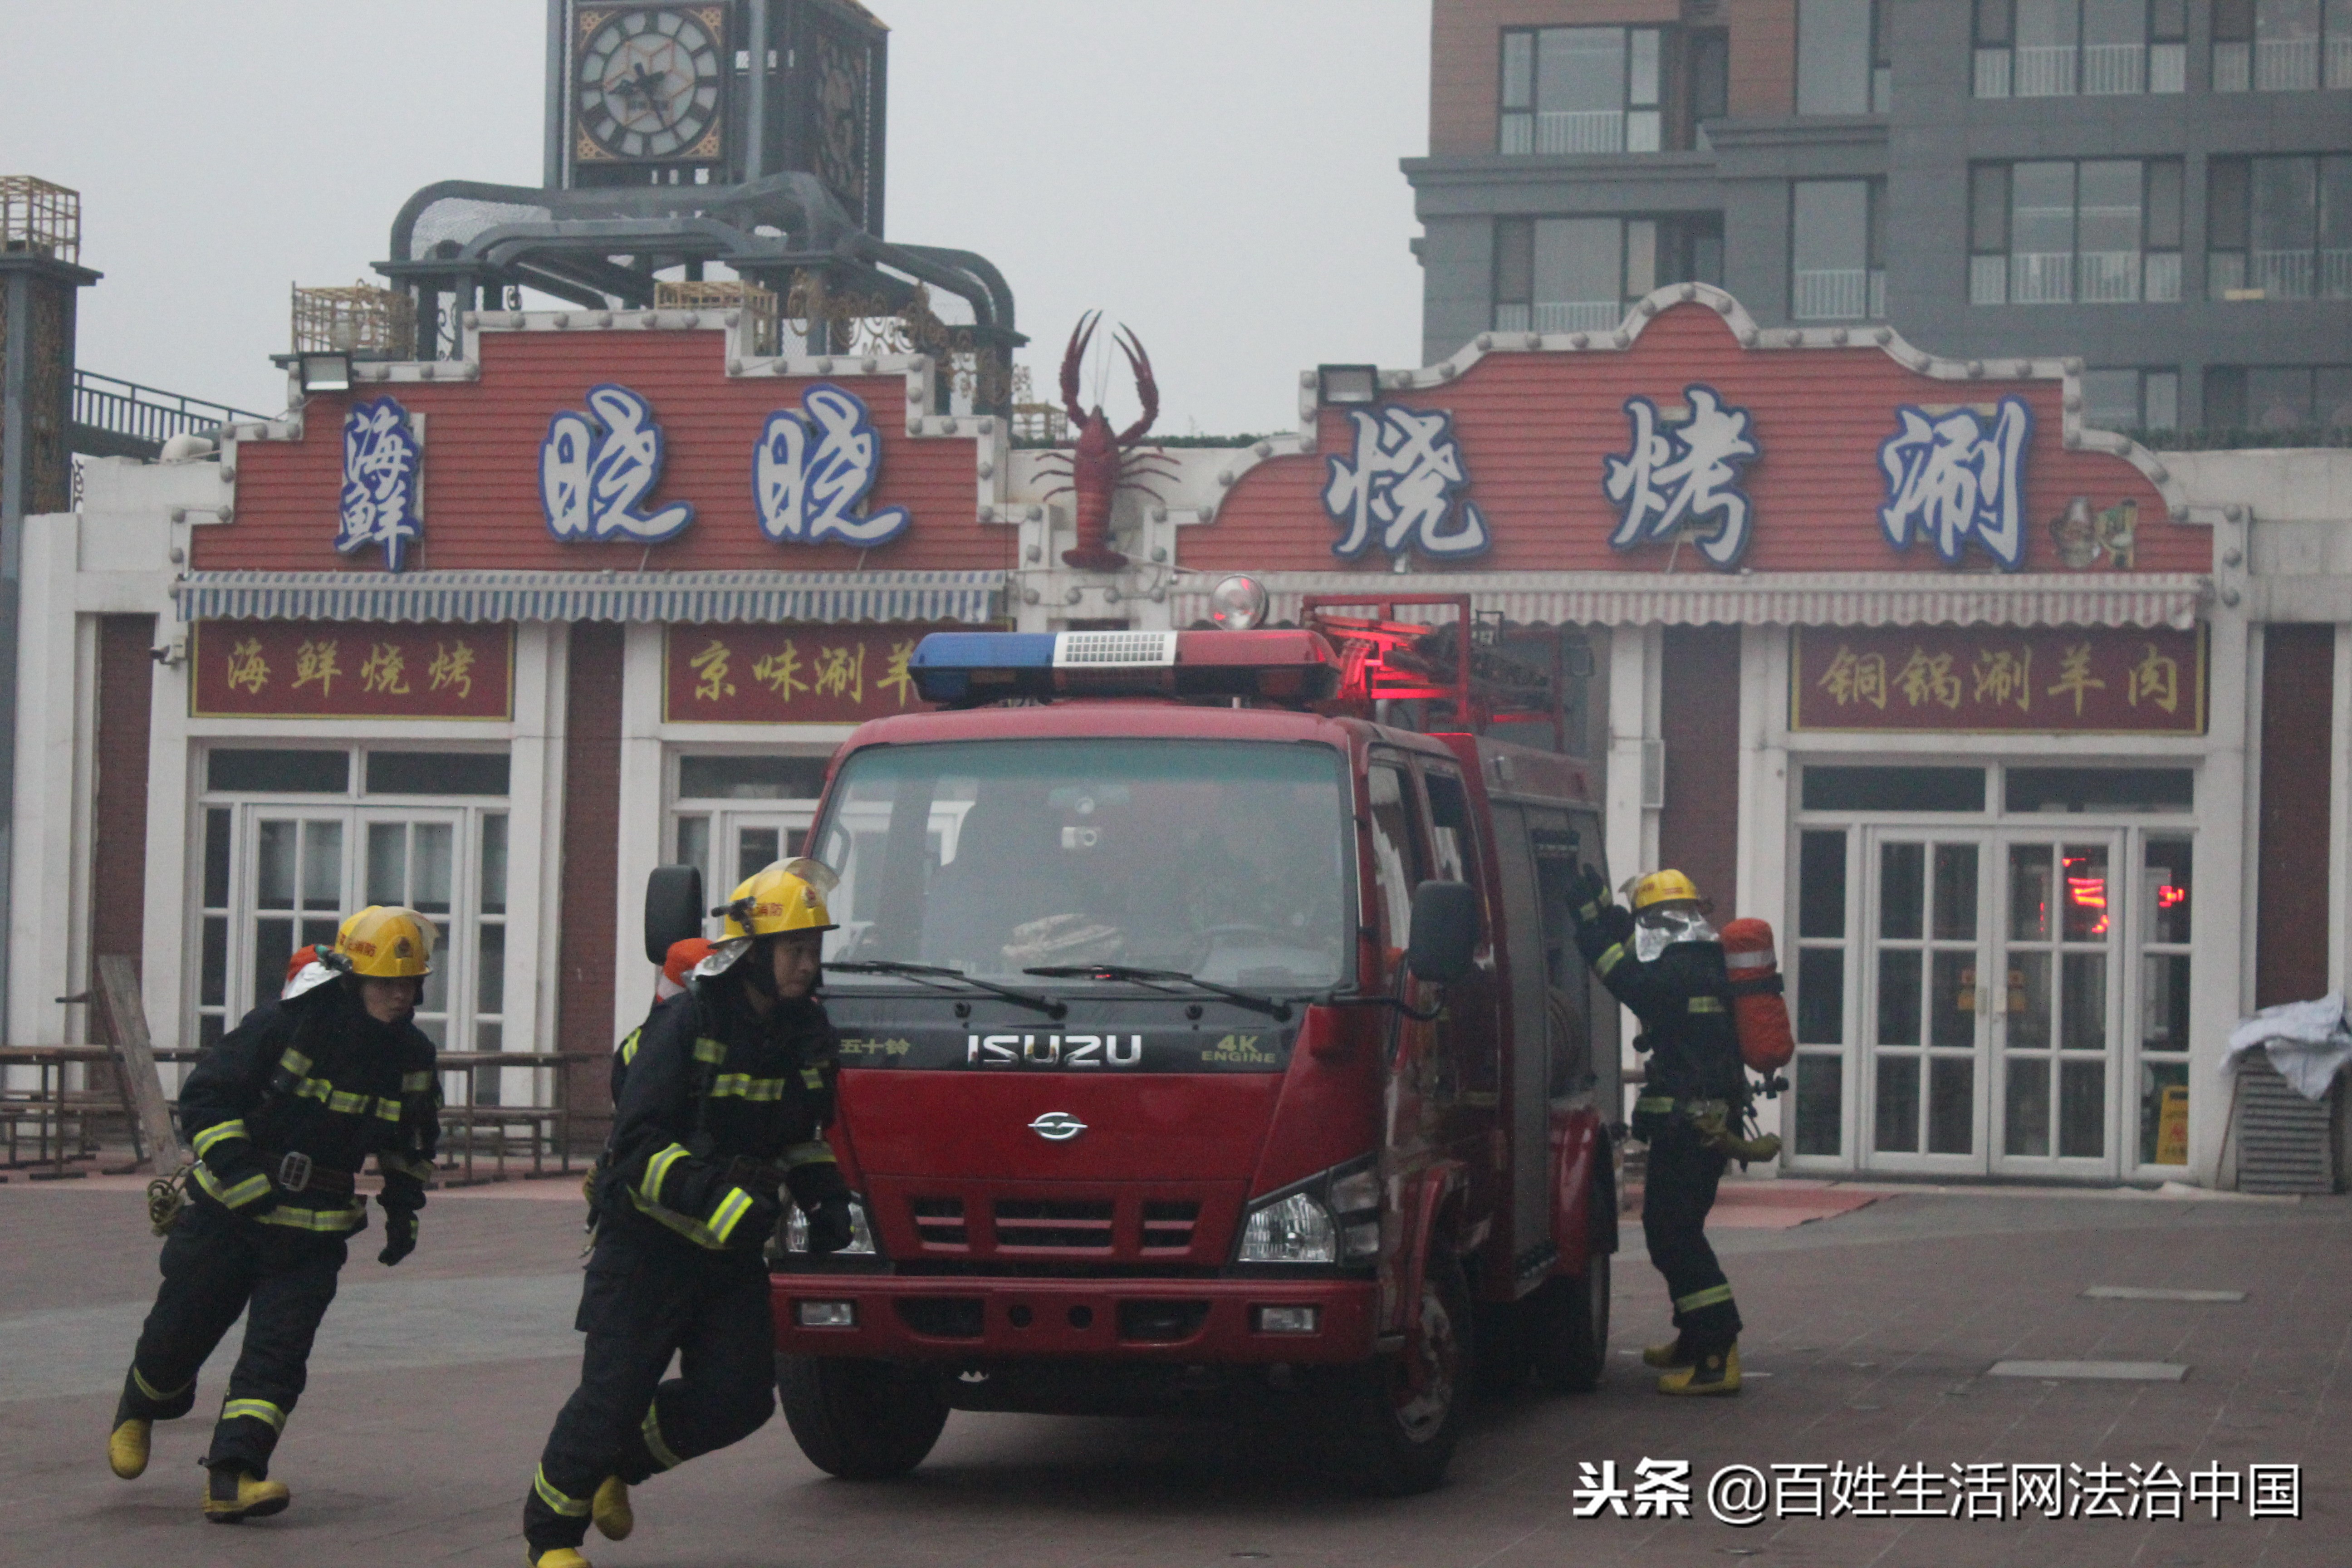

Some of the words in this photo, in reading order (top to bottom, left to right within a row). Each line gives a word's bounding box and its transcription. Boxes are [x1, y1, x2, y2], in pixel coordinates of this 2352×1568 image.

[334, 396, 420, 572] 海鲜
[1322, 384, 2034, 568] 烧烤涮
[228, 637, 475, 699] 海鲜烧烤
[968, 1034, 1142, 1067] ISUZU
[1201, 1050, 1275, 1063] ENGINE
[1217, 1034, 1259, 1053] 4K
